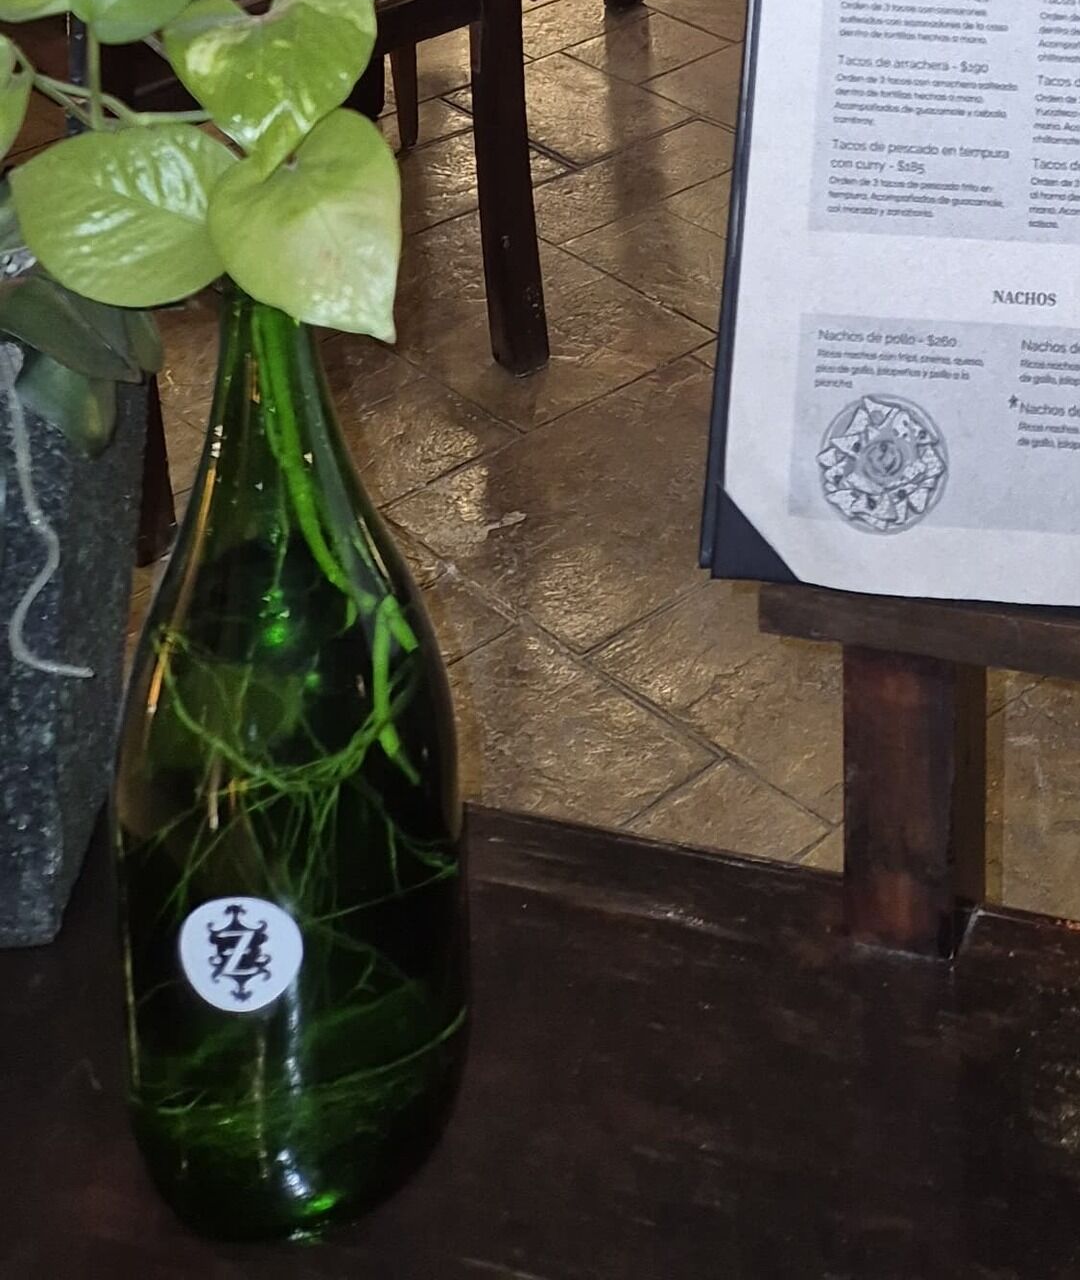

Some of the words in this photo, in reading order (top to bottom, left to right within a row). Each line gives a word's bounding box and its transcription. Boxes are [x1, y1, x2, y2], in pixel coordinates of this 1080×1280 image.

[837, 54, 872, 67] Tacos
[875, 57, 891, 68] de
[892, 60, 950, 71] arrachera
[1037, 75, 1072, 87] Tacos
[832, 138, 867, 151] Tacos
[868, 141, 885, 152] de
[887, 144, 939, 155] pescado
[941, 146, 956, 156] en
[830, 159, 853, 168] con
[855, 160, 886, 173] curry
[1031, 158, 1067, 170] Tacos
[993, 290, 1057, 307] NACHOS
[818, 329, 864, 342] Nachos
[866, 331, 883, 343] de
[884, 333, 917, 345] pollo
[1021, 340, 1067, 353] Nachos
[1019, 402, 1065, 416] Nachos
